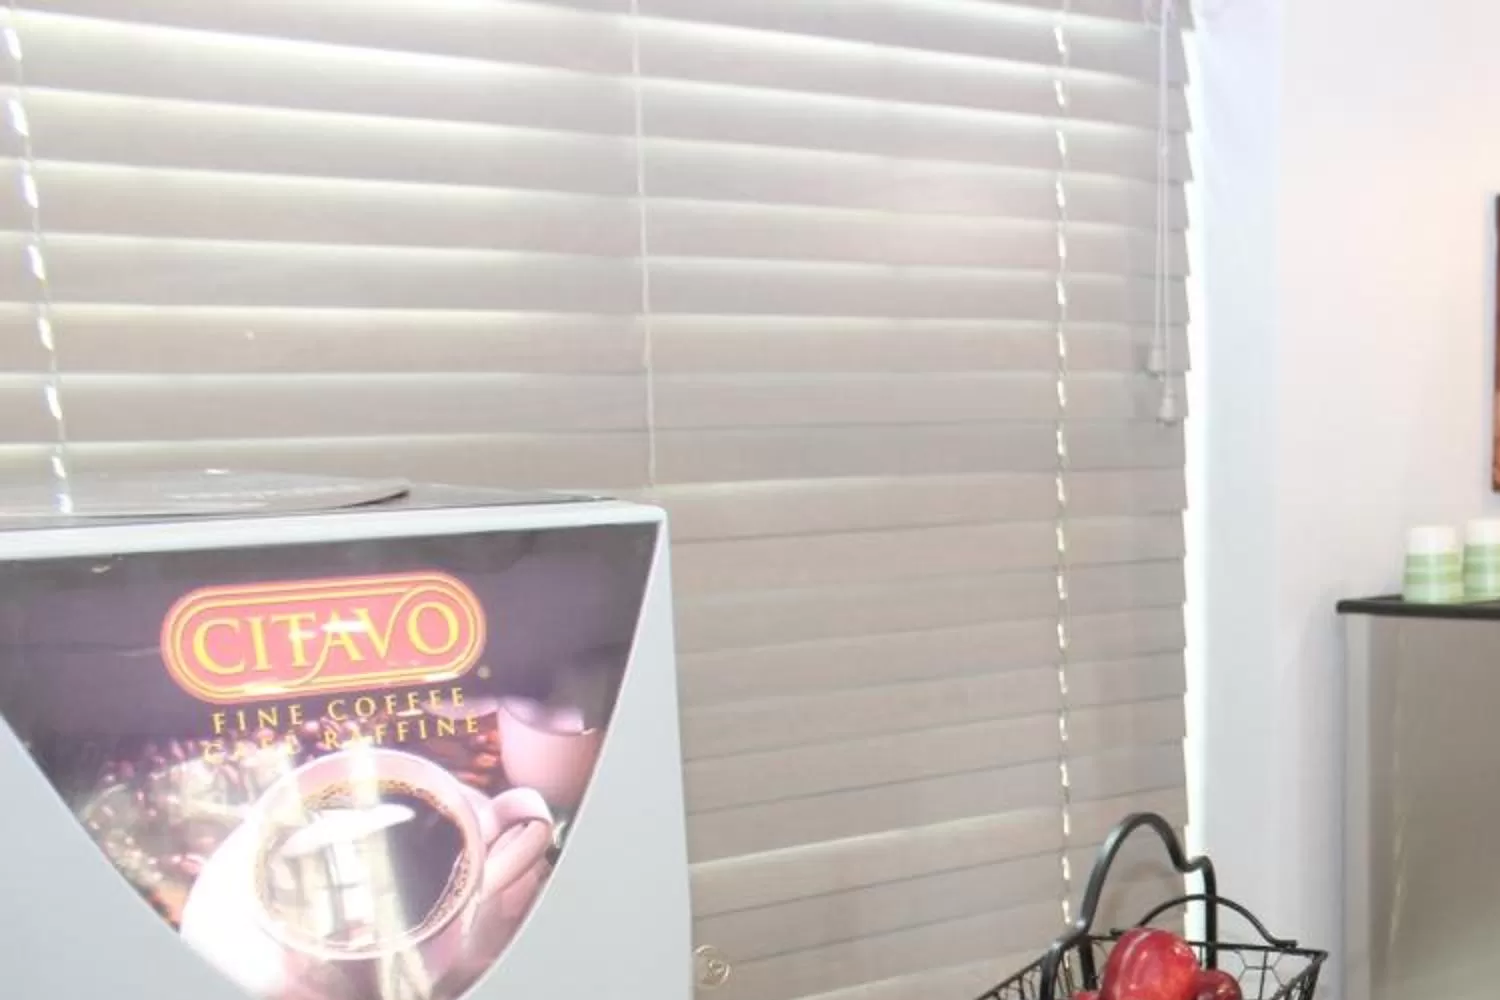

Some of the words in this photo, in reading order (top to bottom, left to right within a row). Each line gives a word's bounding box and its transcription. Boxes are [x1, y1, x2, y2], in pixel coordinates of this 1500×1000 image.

[192, 600, 460, 675] CITAVO
[212, 704, 303, 734] FINE
[327, 687, 466, 721] COFFEE
